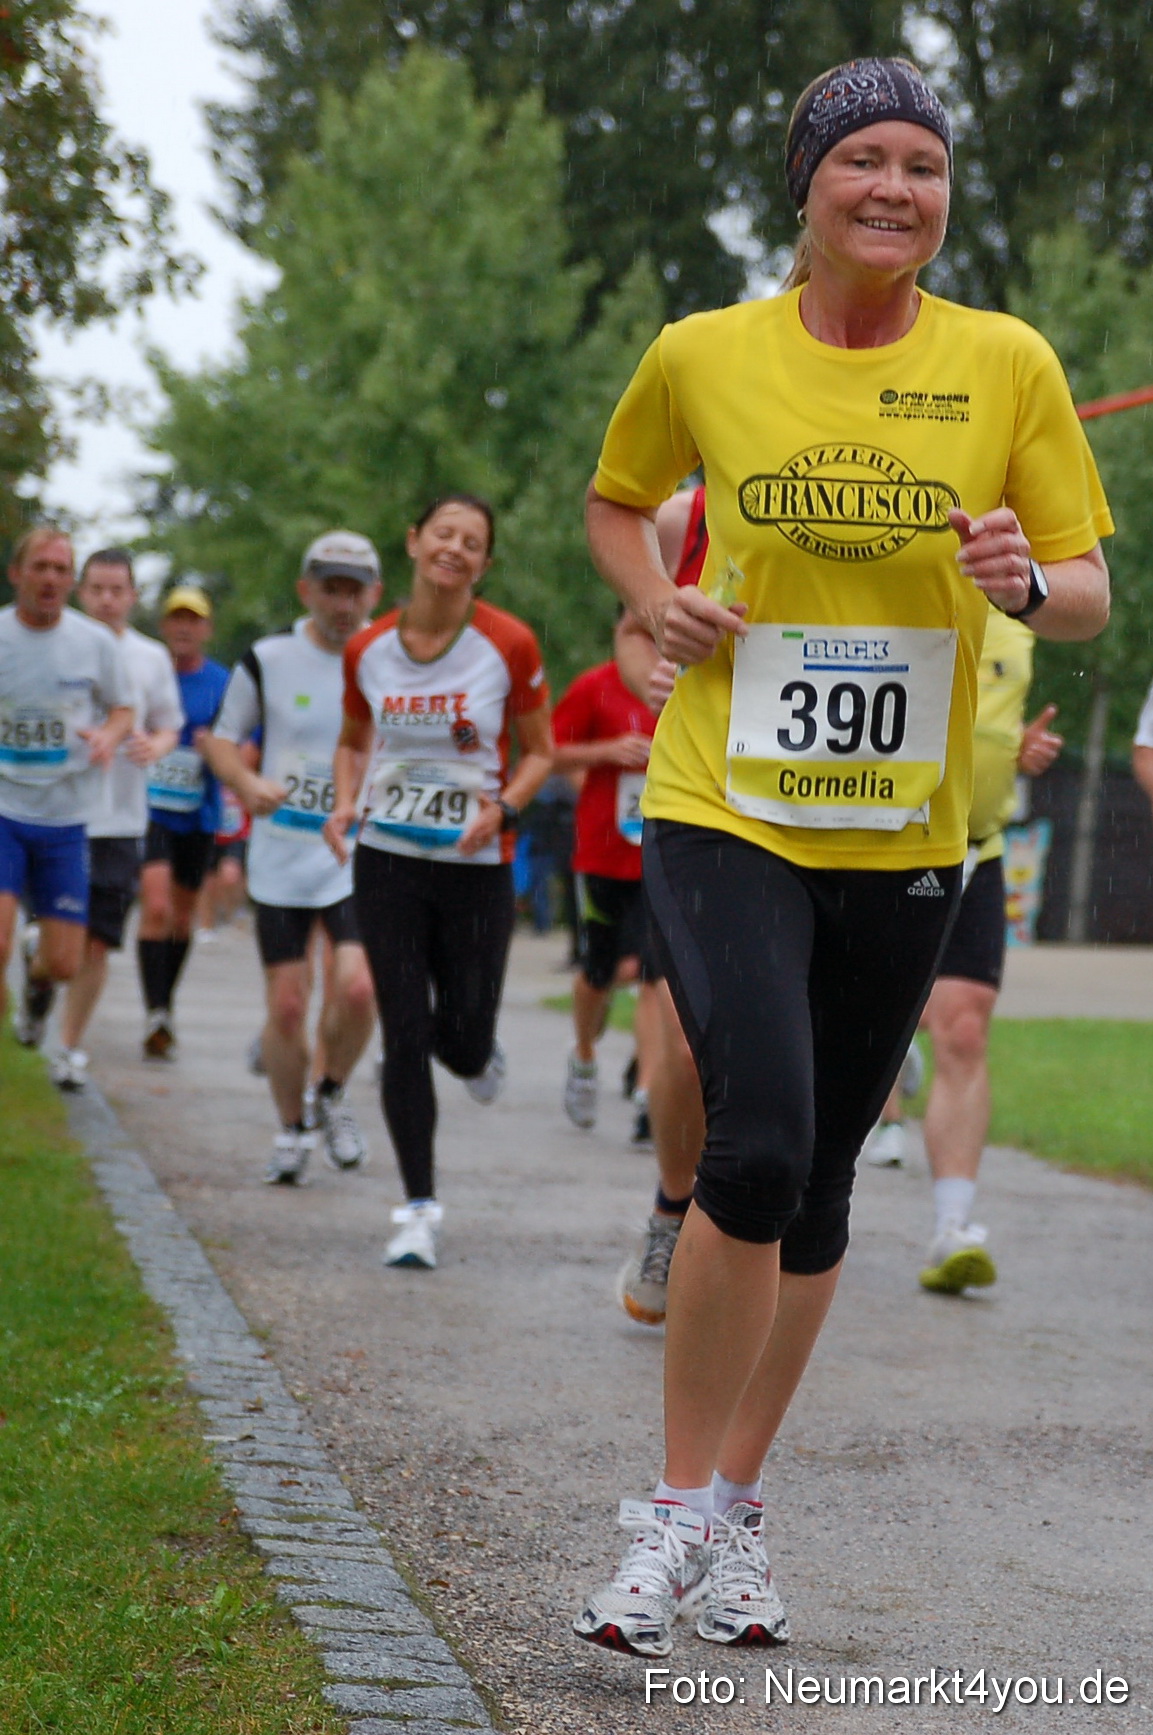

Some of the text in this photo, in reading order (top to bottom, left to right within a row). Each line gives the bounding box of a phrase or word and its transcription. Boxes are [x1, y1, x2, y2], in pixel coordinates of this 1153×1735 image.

[787, 448, 906, 482] PIZZERIA
[763, 482, 934, 524] FRANCESCO
[788, 525, 908, 558] HERSBRUCK
[803, 639, 889, 660] BOCK
[1, 718, 65, 748] 2649
[776, 680, 908, 756] 390
[284, 772, 337, 813] 256
[778, 768, 895, 799] Cornelia
[384, 784, 467, 825] 2749
[907, 886, 945, 897] adidas
